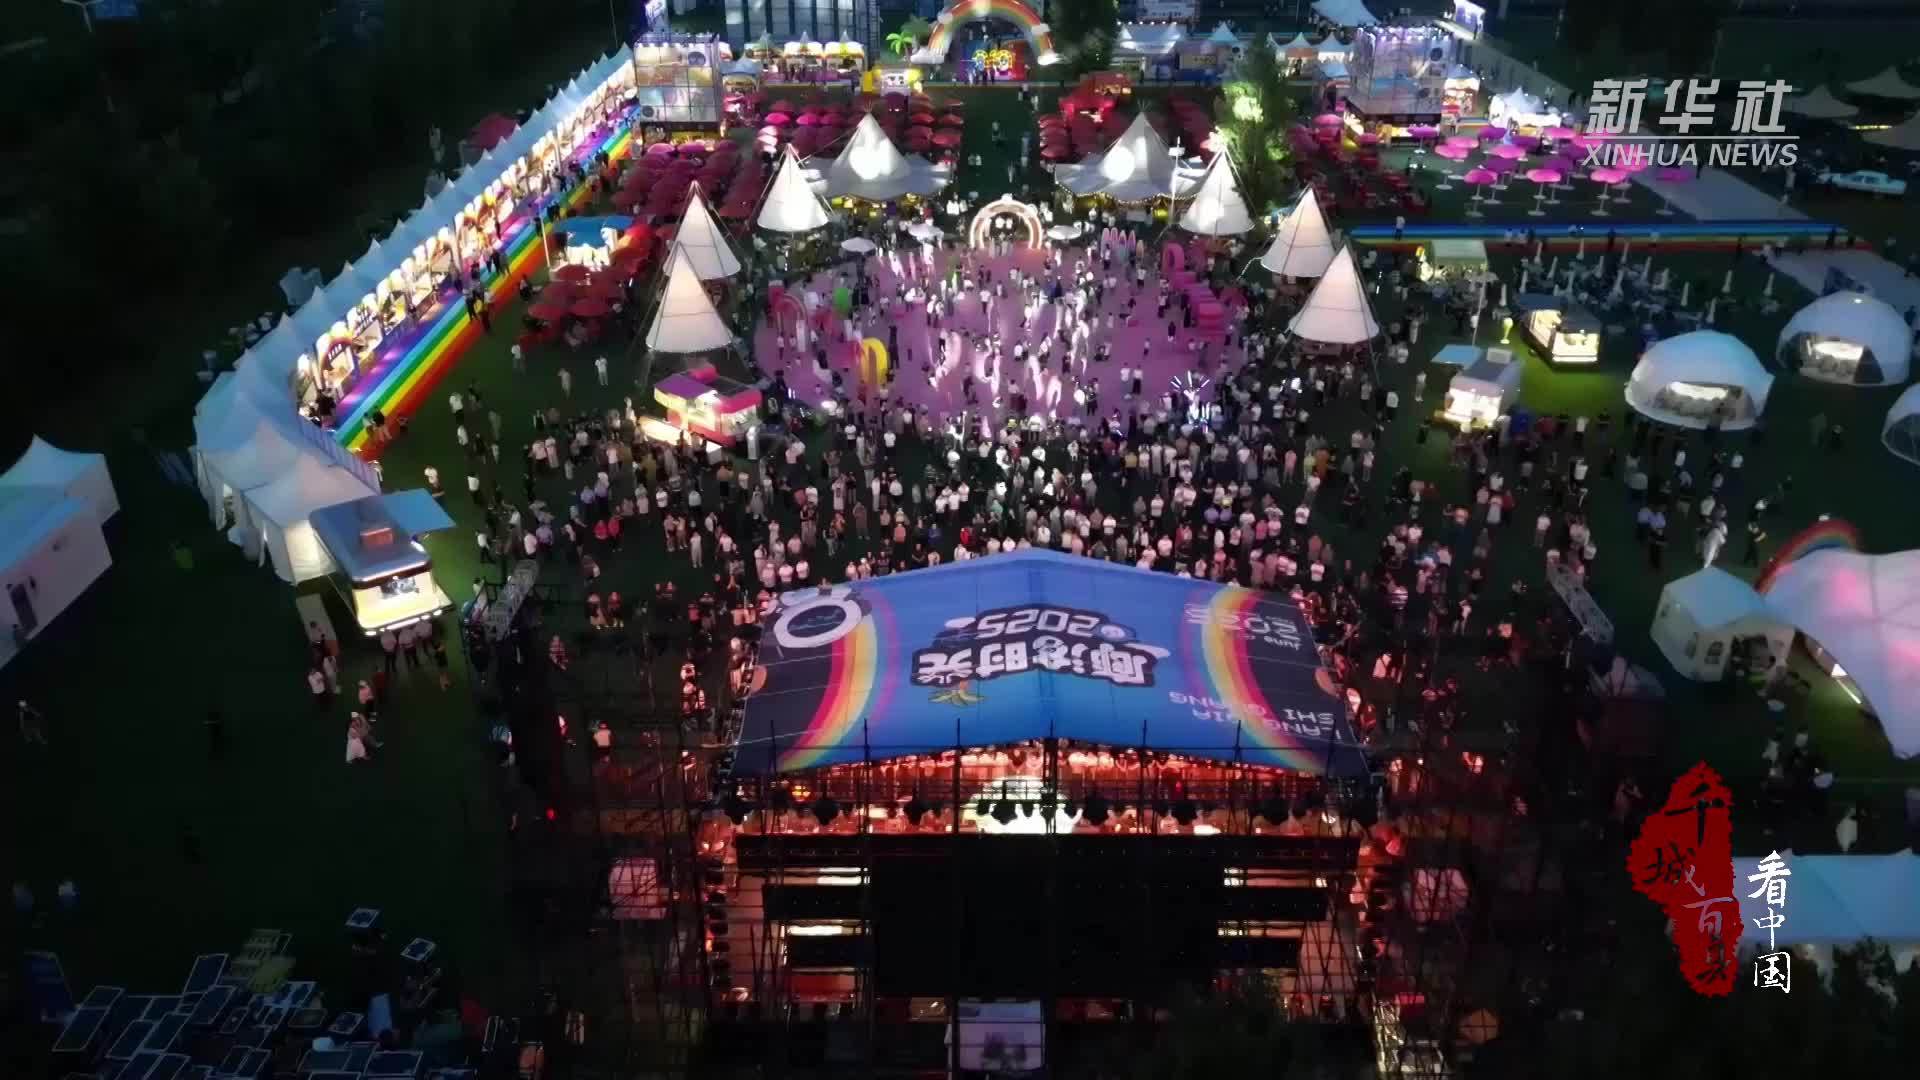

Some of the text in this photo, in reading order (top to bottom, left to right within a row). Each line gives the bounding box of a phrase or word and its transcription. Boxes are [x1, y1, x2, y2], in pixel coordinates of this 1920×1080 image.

[976, 609, 1099, 639] 2025
[1168, 691, 1334, 725] SHI GANG
